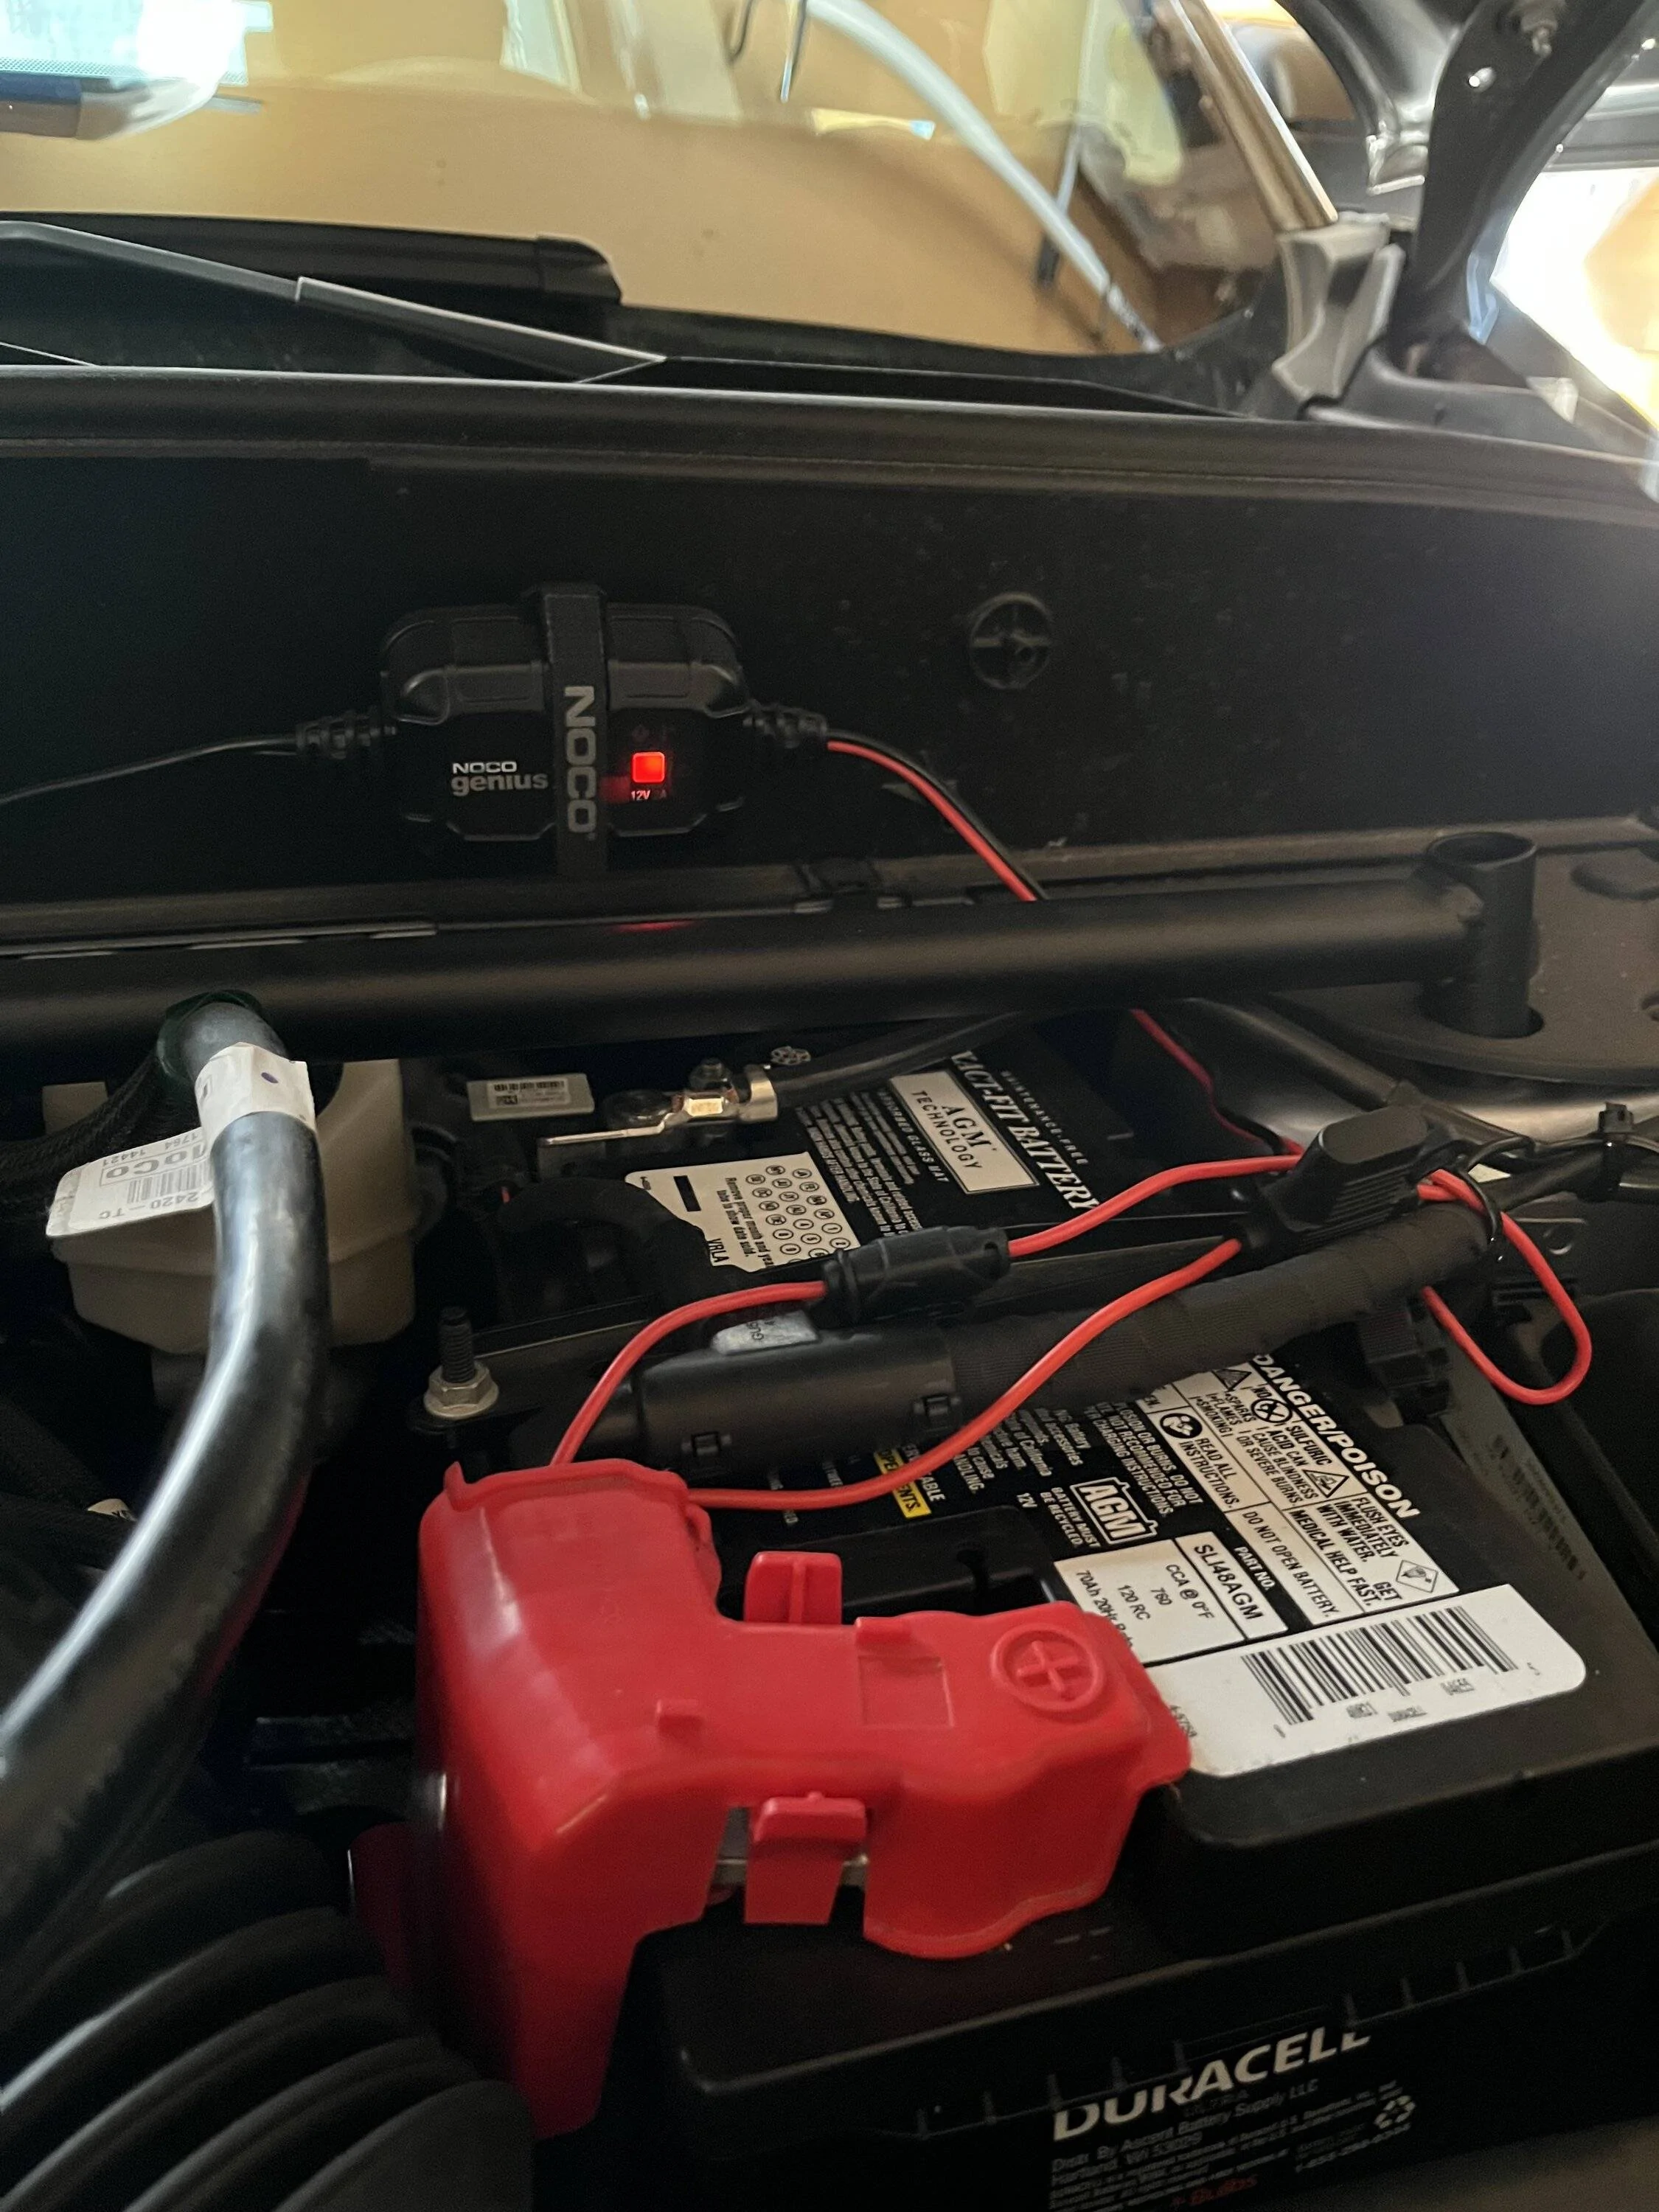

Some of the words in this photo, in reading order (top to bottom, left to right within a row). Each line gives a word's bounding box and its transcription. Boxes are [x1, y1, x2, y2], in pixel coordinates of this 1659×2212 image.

[451, 761, 518, 774] NOCO
[564, 685, 598, 833] NOCO
[451, 772, 549, 797] genius
[631, 790, 651, 801] 12V
[911, 1090, 982, 1171] TECHNOLOGY
[939, 1102, 992, 1149] AGM
[947, 1050, 1030, 1127] XACT-FIT
[1007, 1122, 1102, 1211] BATTERY
[906, 1133, 935, 1163] GLASS
[725, 1176, 745, 1200] Remove
[706, 1238, 729, 1262] VRLA
[732, 1225, 748, 1239] date
[754, 1240, 770, 1253] and
[757, 1253, 774, 1267] yea
[1043, 1422, 1083, 1466] accessories
[1091, 1418, 1131, 1458] CHARGING
[1236, 1435, 1253, 1446] OR
[1245, 1447, 1279, 1475] SEVERE
[1251, 1353, 1421, 1518] DANGER/POISON
[1265, 1428, 1295, 1450] ACID
[1285, 1450, 1309, 1467] CAN
[1284, 1424, 1332, 1466] SULFURIC
[951, 1453, 987, 1494] ANDLING.
[1178, 1440, 1242, 1508] INSTRUCTIONS.
[1194, 1437, 1223, 1461] READ
[1214, 1461, 1238, 1479] ALL
[1251, 1432, 1281, 1455] CAUSE
[1273, 1456, 1319, 1499] BLINDNESS
[1015, 1492, 1038, 1509] 12V
[1039, 1492, 1055, 1503] BE
[1050, 1486, 1083, 1522] BATTERY
[1075, 1523, 1102, 1548] MUST
[1078, 1484, 1148, 1538] AGM
[1163, 1489, 1186, 1507] FOR
[1315, 1504, 1347, 1527] WITH
[1337, 1527, 1378, 1562] WATER.
[1333, 1500, 1398, 1559] IMMEDIATELY
[1351, 1496, 1387, 1524] FLUSH
[1376, 1523, 1410, 1548] EYES
[1233, 1545, 1263, 1571] PART
[1253, 1571, 1278, 1590] NO.
[1242, 1512, 1264, 1525] DO
[1254, 1525, 1281, 1544] NOT
[1270, 1544, 1302, 1571] OPEN
[1292, 1571, 1340, 1617] BATTERY.
[1288, 1509, 1335, 1550] MEDICAL
[1324, 1550, 1358, 1576] HELP
[1346, 1576, 1382, 1606] FAST.
[1076, 1570, 1103, 1596] 70Ah
[1164, 1563, 1191, 1587] CCA
[1178, 1587, 1200, 1601] @
[1192, 1543, 1264, 1620] SLI48AGM
[1371, 1581, 1402, 1602] GET
[1116, 1584, 1140, 1604] 120
[1130, 1602, 1152, 1621] RC
[1052, 2025, 1371, 2141] DURACELL
